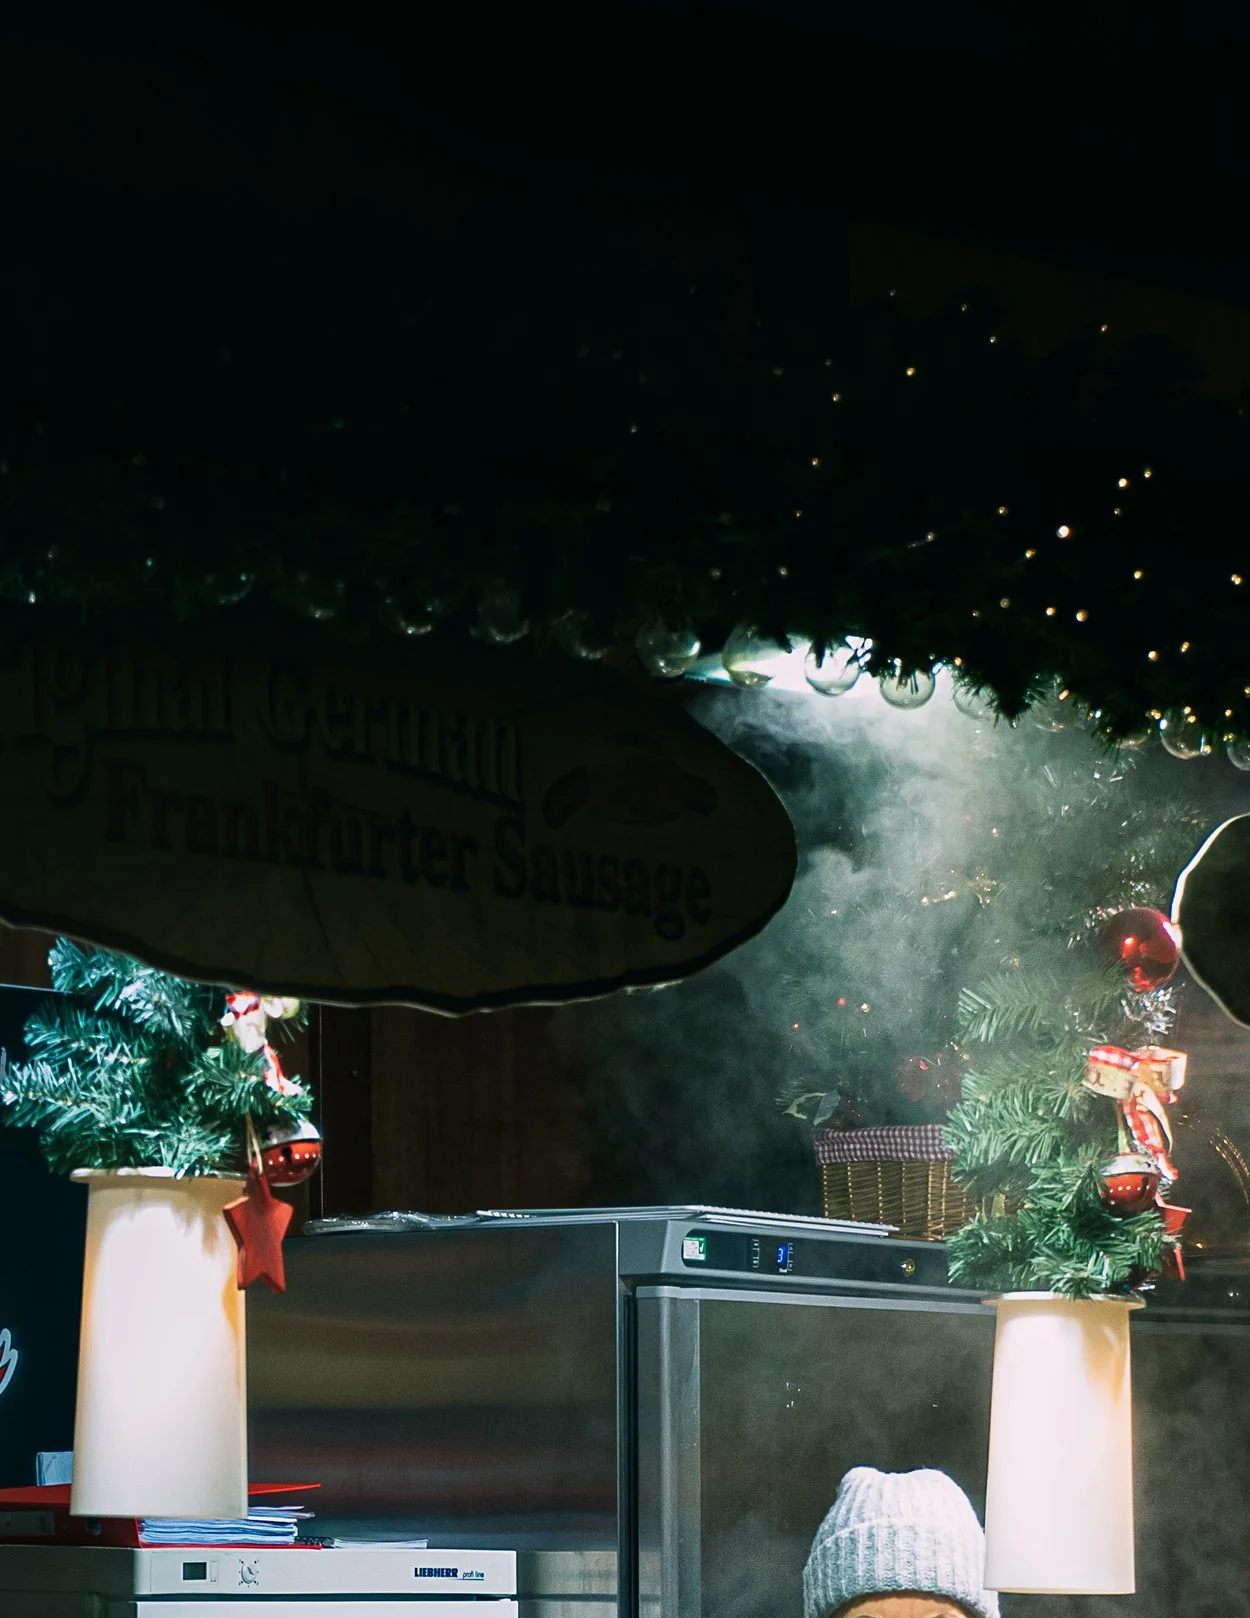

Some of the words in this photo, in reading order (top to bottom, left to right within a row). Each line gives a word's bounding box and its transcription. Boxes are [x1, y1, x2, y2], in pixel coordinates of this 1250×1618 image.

[258, 660, 528, 812] German
[103, 756, 479, 892] Frankfurter
[494, 814, 714, 942] Sausage
[414, 1567, 459, 1578] LIEBHERR
[462, 1571, 474, 1580] profi
